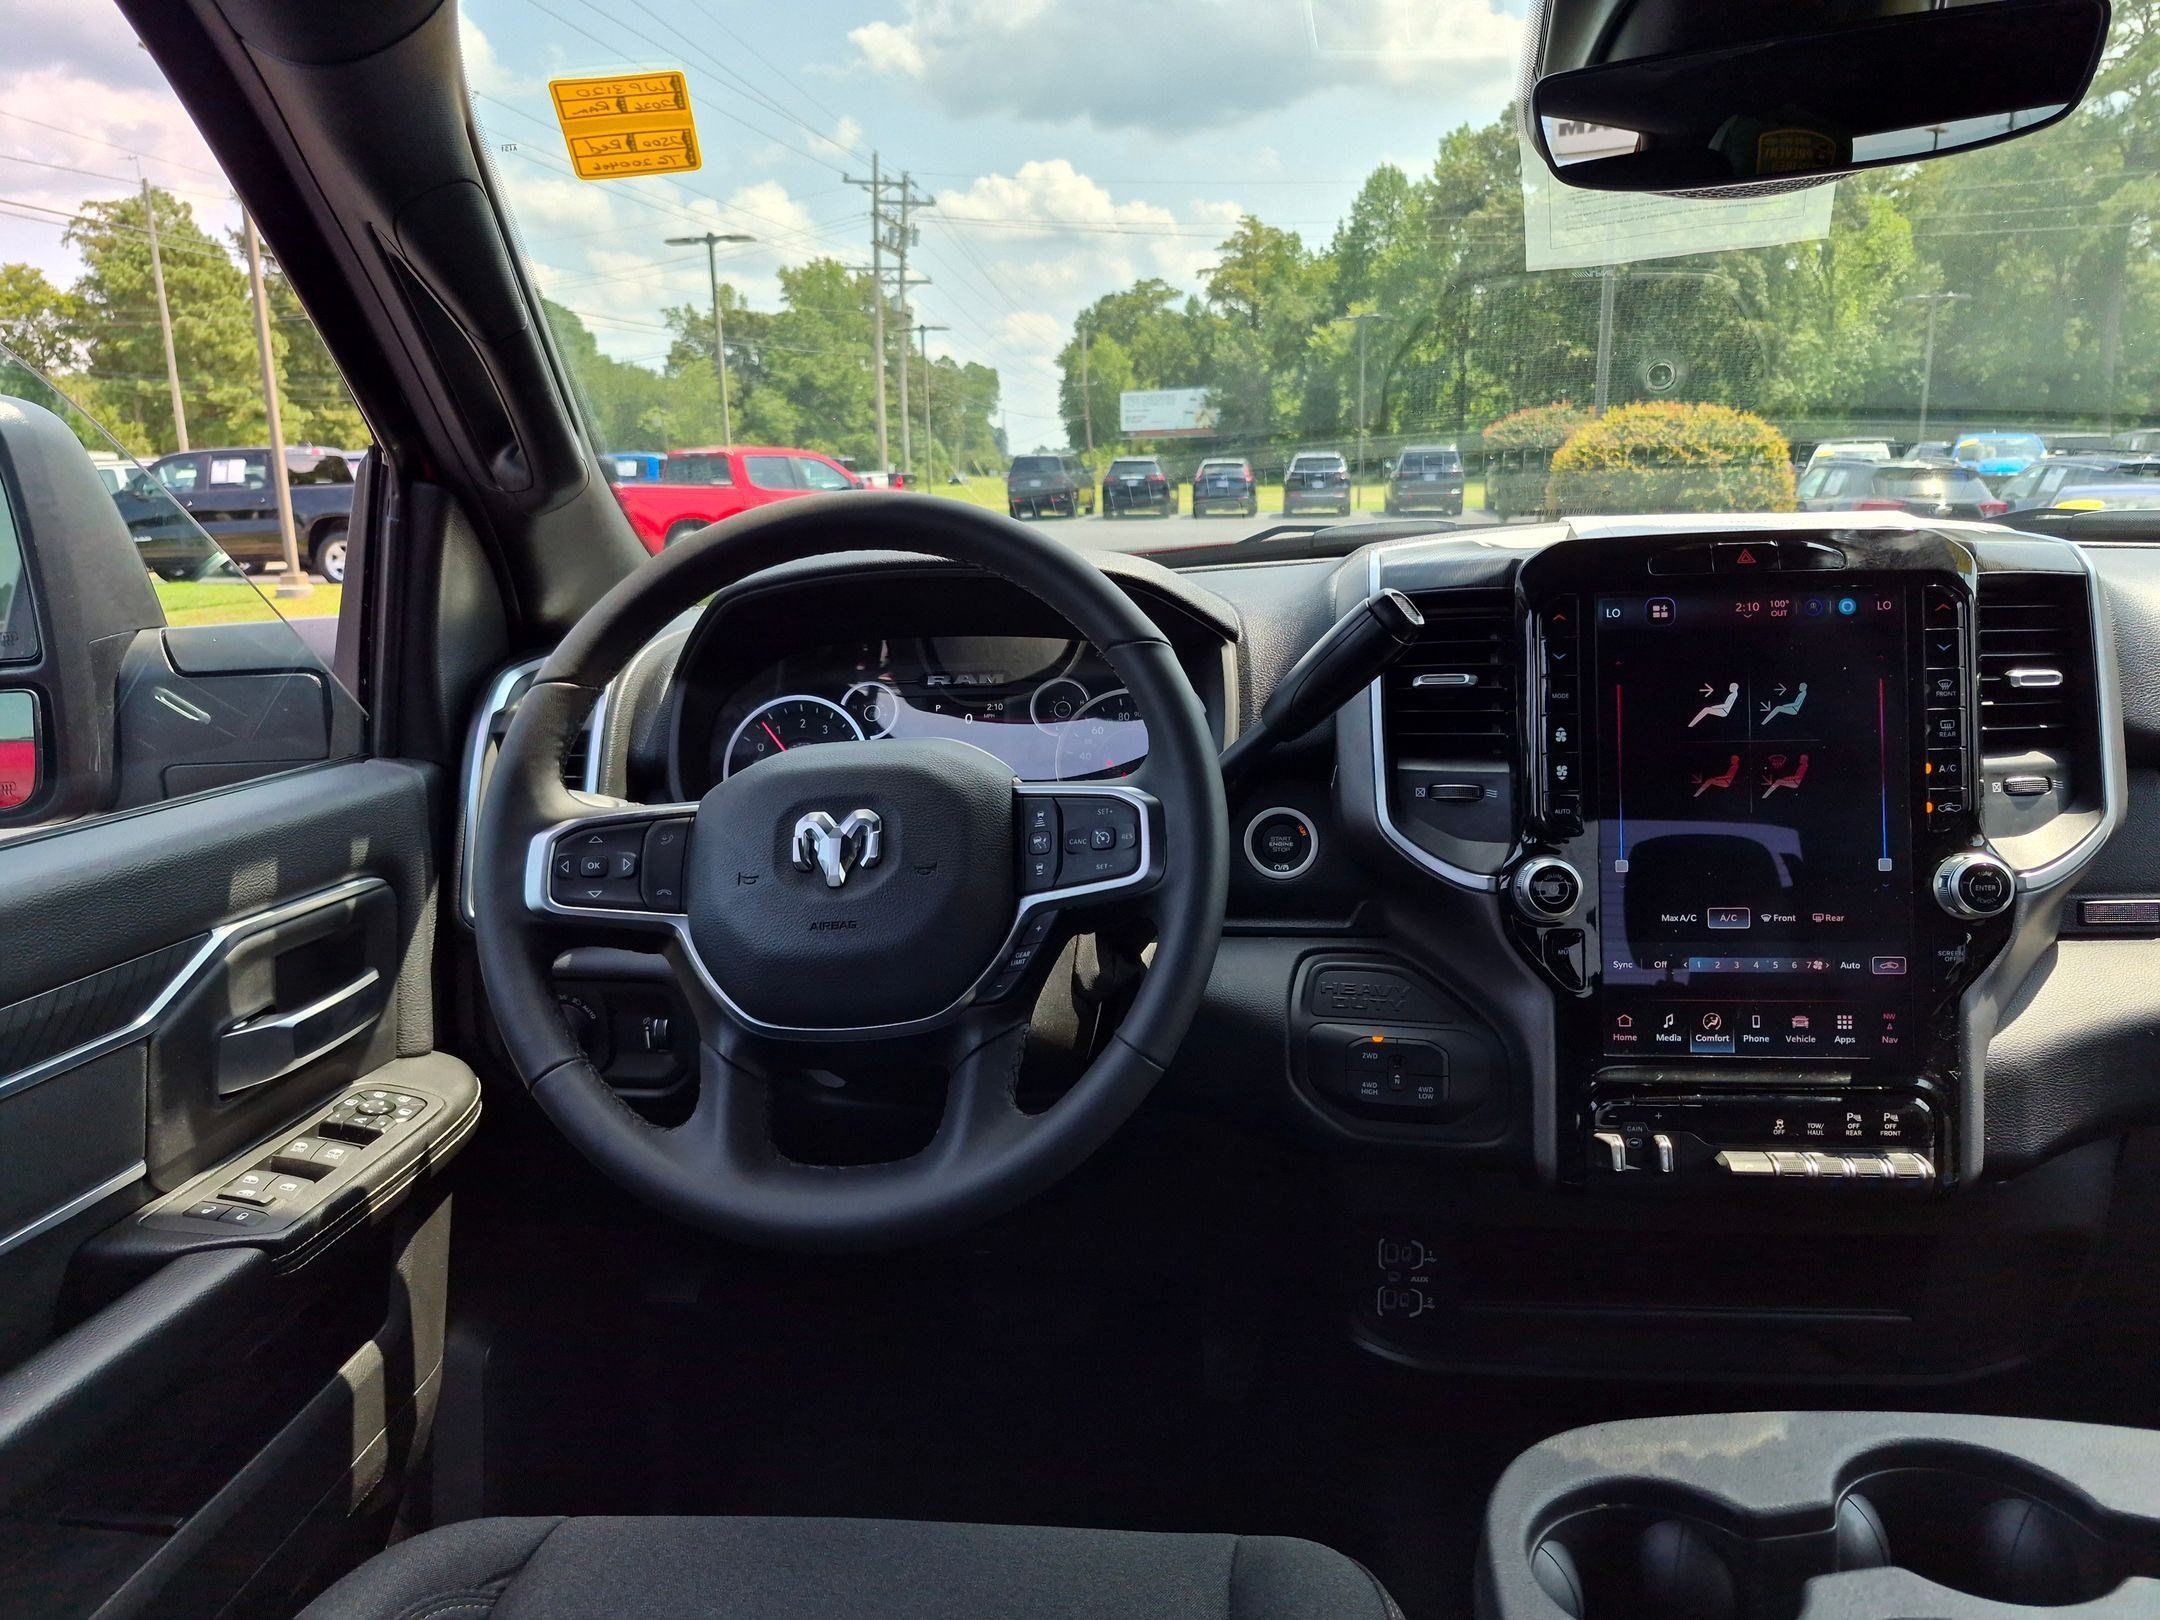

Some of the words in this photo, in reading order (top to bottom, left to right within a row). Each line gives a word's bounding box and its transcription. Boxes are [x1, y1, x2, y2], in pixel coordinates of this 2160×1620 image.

[1735, 602, 1760, 613] 2:10
[1876, 600, 1892, 611] LO
[1606, 608, 1621, 618] LO
[1770, 609, 1788, 617] OUT
[927, 674, 1005, 686] RAM
[935, 704, 941, 712] P
[986, 703, 1004, 711] 2:10
[964, 713, 973, 725] 0
[1118, 712, 1130, 722] 80
[800, 718, 807, 729] 2
[775, 725, 782, 735] 1
[822, 724, 829, 735] 3
[1091, 726, 1105, 736] 60
[757, 742, 765, 752] 0
[1079, 751, 1092, 761] 40
[1938, 764, 1957, 773] A/C
[587, 862, 601, 870] OK
[1974, 884, 1997, 892] ENTER
[1661, 914, 1678, 922] Max
[1680, 914, 1698, 922] A/C
[1719, 914, 1738, 922] A/C
[1773, 913, 1797, 922] Front
[1825, 913, 1845, 922] Rear
[809, 920, 857, 931] AIRBAG
[1015, 950, 1031, 959] GEAR
[1010, 958, 1026, 966] LIMIT
[1613, 960, 1633, 970] Sync
[1653, 960, 1668, 969] Off
[1753, 961, 1760, 969] 4
[1772, 961, 1779, 969] 5
[1791, 961, 1798, 969] 6
[1806, 961, 1812, 969] 7
[1840, 961, 1861, 970] Auto
[1320, 981, 1411, 997] HEAVY
[1331, 995, 1406, 1011] DUTY
[1612, 1033, 1638, 1042] Home
[1655, 1033, 1682, 1042] Media
[1695, 1034, 1730, 1042] Comfort
[1743, 1034, 1770, 1043] Phone
[1785, 1035, 1817, 1044] Vehicle
[1834, 1035, 1856, 1045] Apps
[1881, 1036, 1899, 1044] Nav
